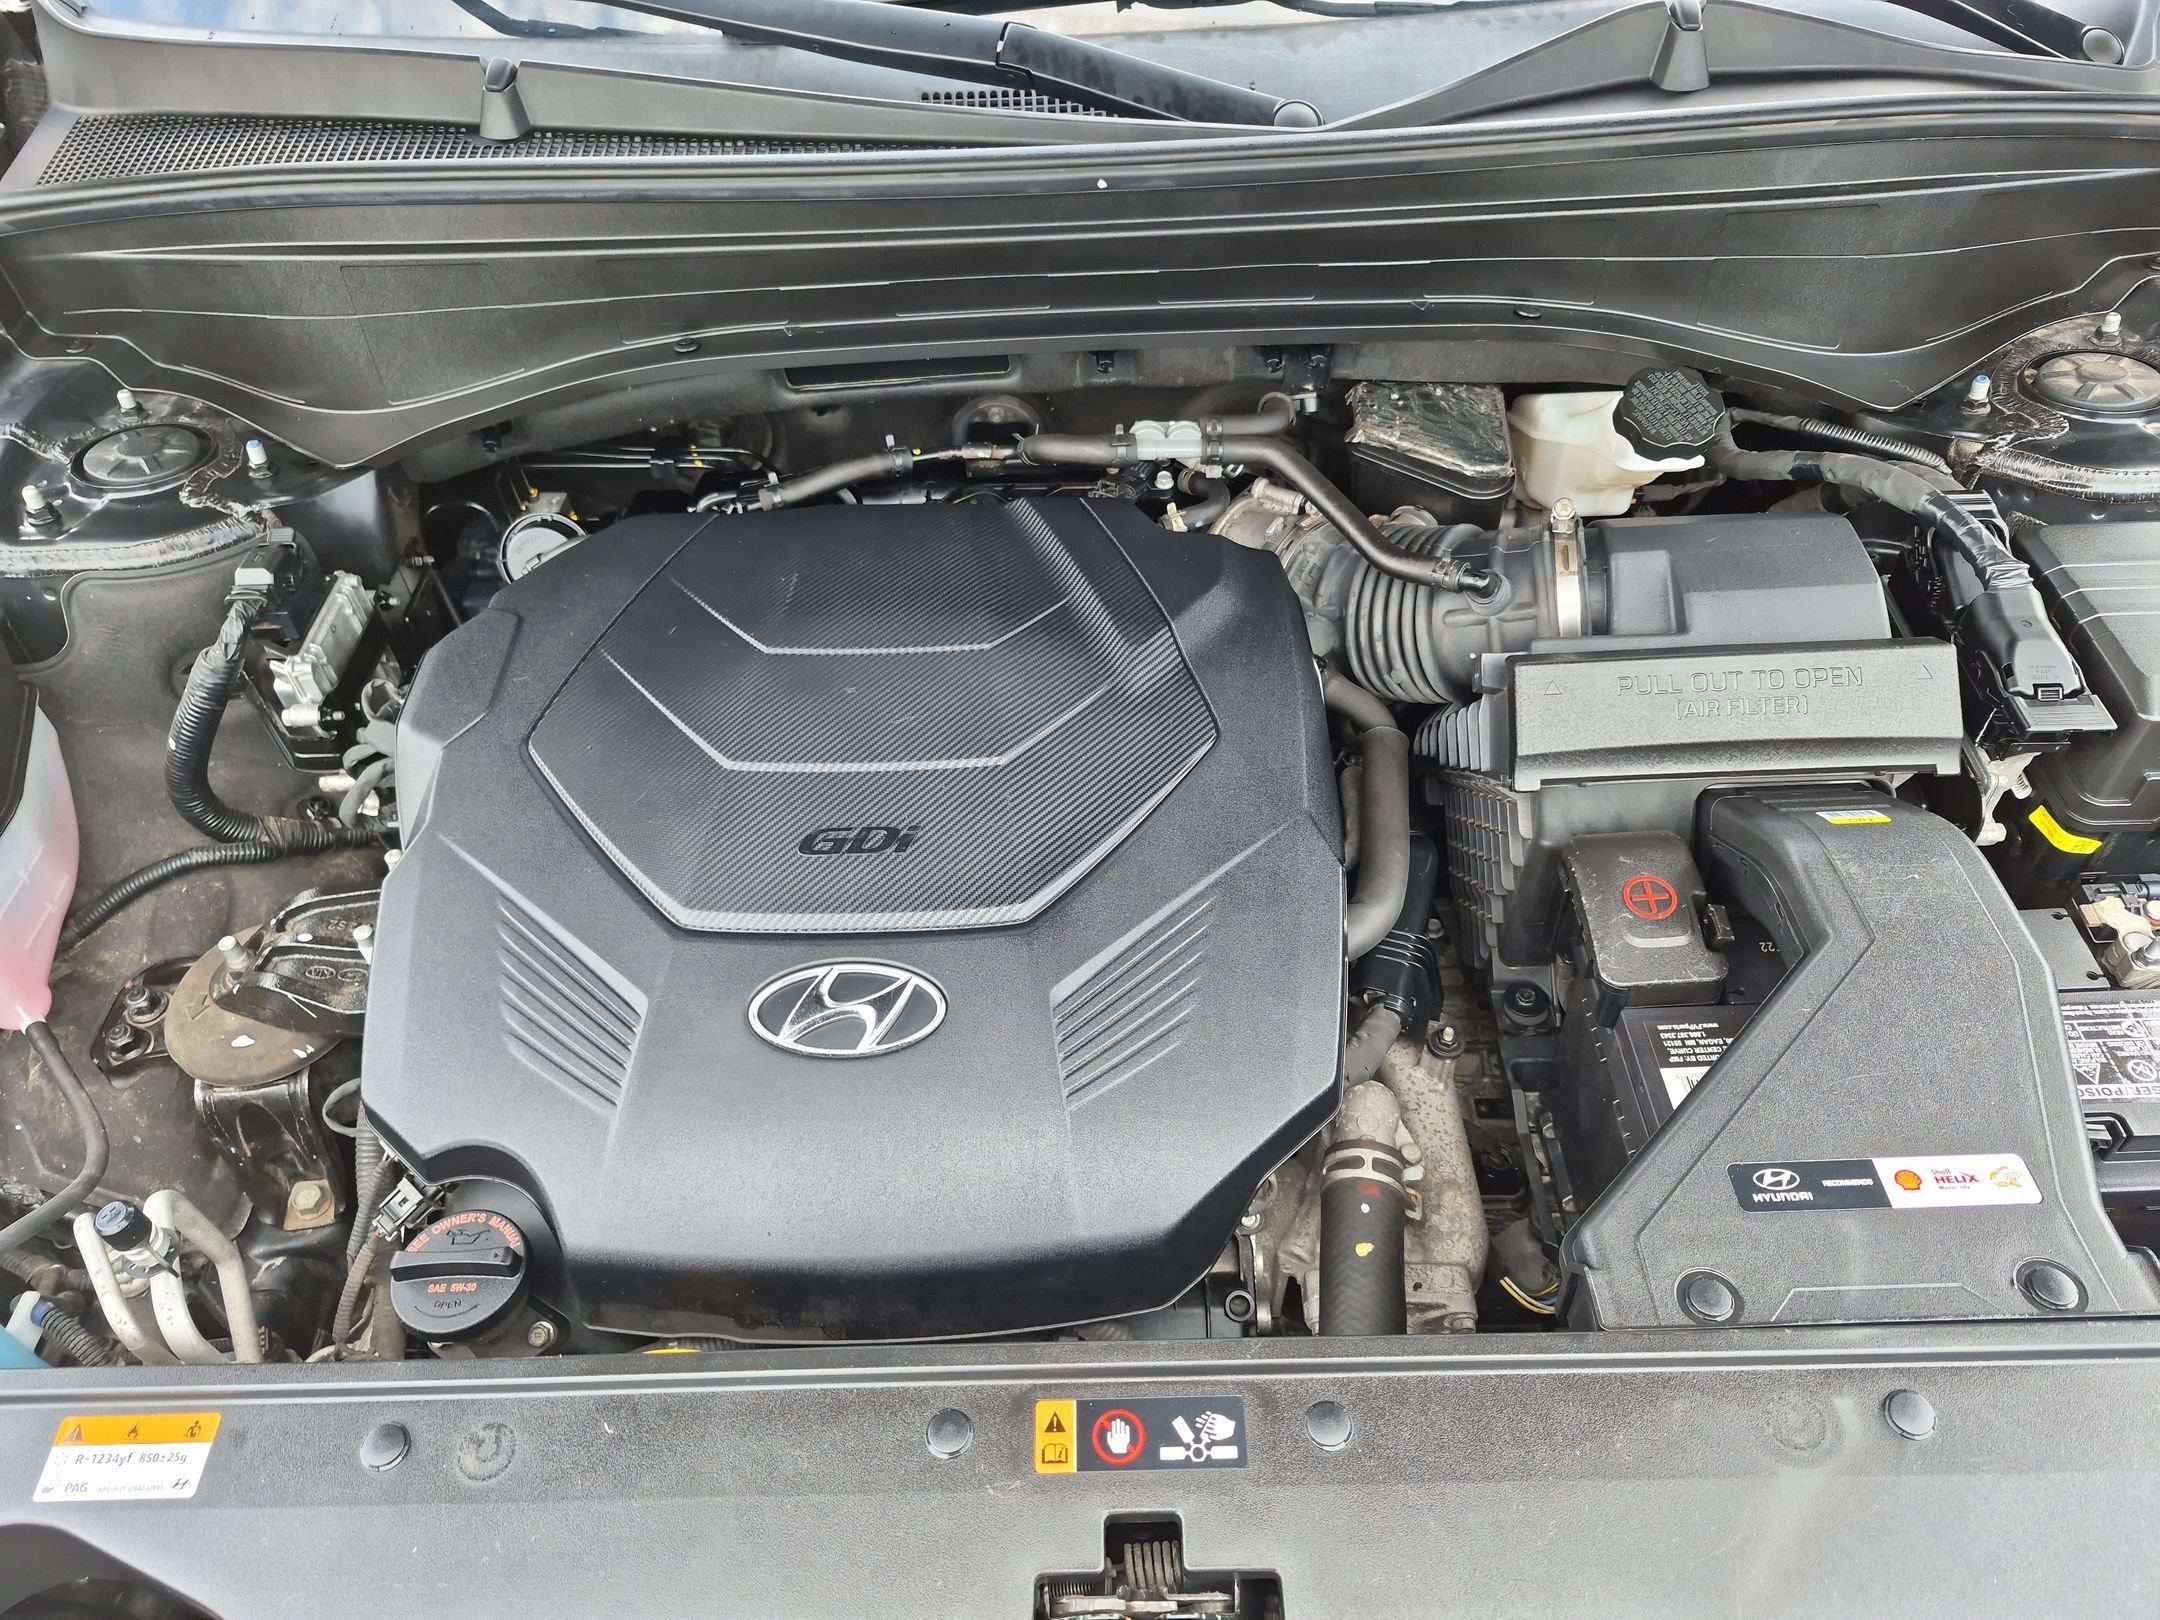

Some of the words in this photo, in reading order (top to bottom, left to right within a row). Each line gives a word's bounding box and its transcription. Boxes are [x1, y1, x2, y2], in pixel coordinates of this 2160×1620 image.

[1617, 674, 1683, 696] PULL
[1691, 671, 1743, 692] OUT
[1751, 669, 1785, 690] TO
[1794, 667, 1863, 689] OPEN
[1675, 699, 1720, 720] (AIR
[1727, 695, 1809, 717] FILTER)
[799, 826, 920, 855] GDi
[1934, 1175, 1980, 1184] HELIX
[1752, 1191, 1814, 1202] HYUNDAI
[407, 1233, 430, 1252] SEE
[432, 1212, 488, 1235] OWNER'S
[489, 1215, 521, 1249] MANUAL
[428, 1283, 448, 1294] SAE
[433, 1299, 462, 1309] OPEN
[75, 1452, 134, 1466] R-1234yf
[139, 1452, 188, 1465] 850±25g
[64, 1482, 89, 1493] PAG
